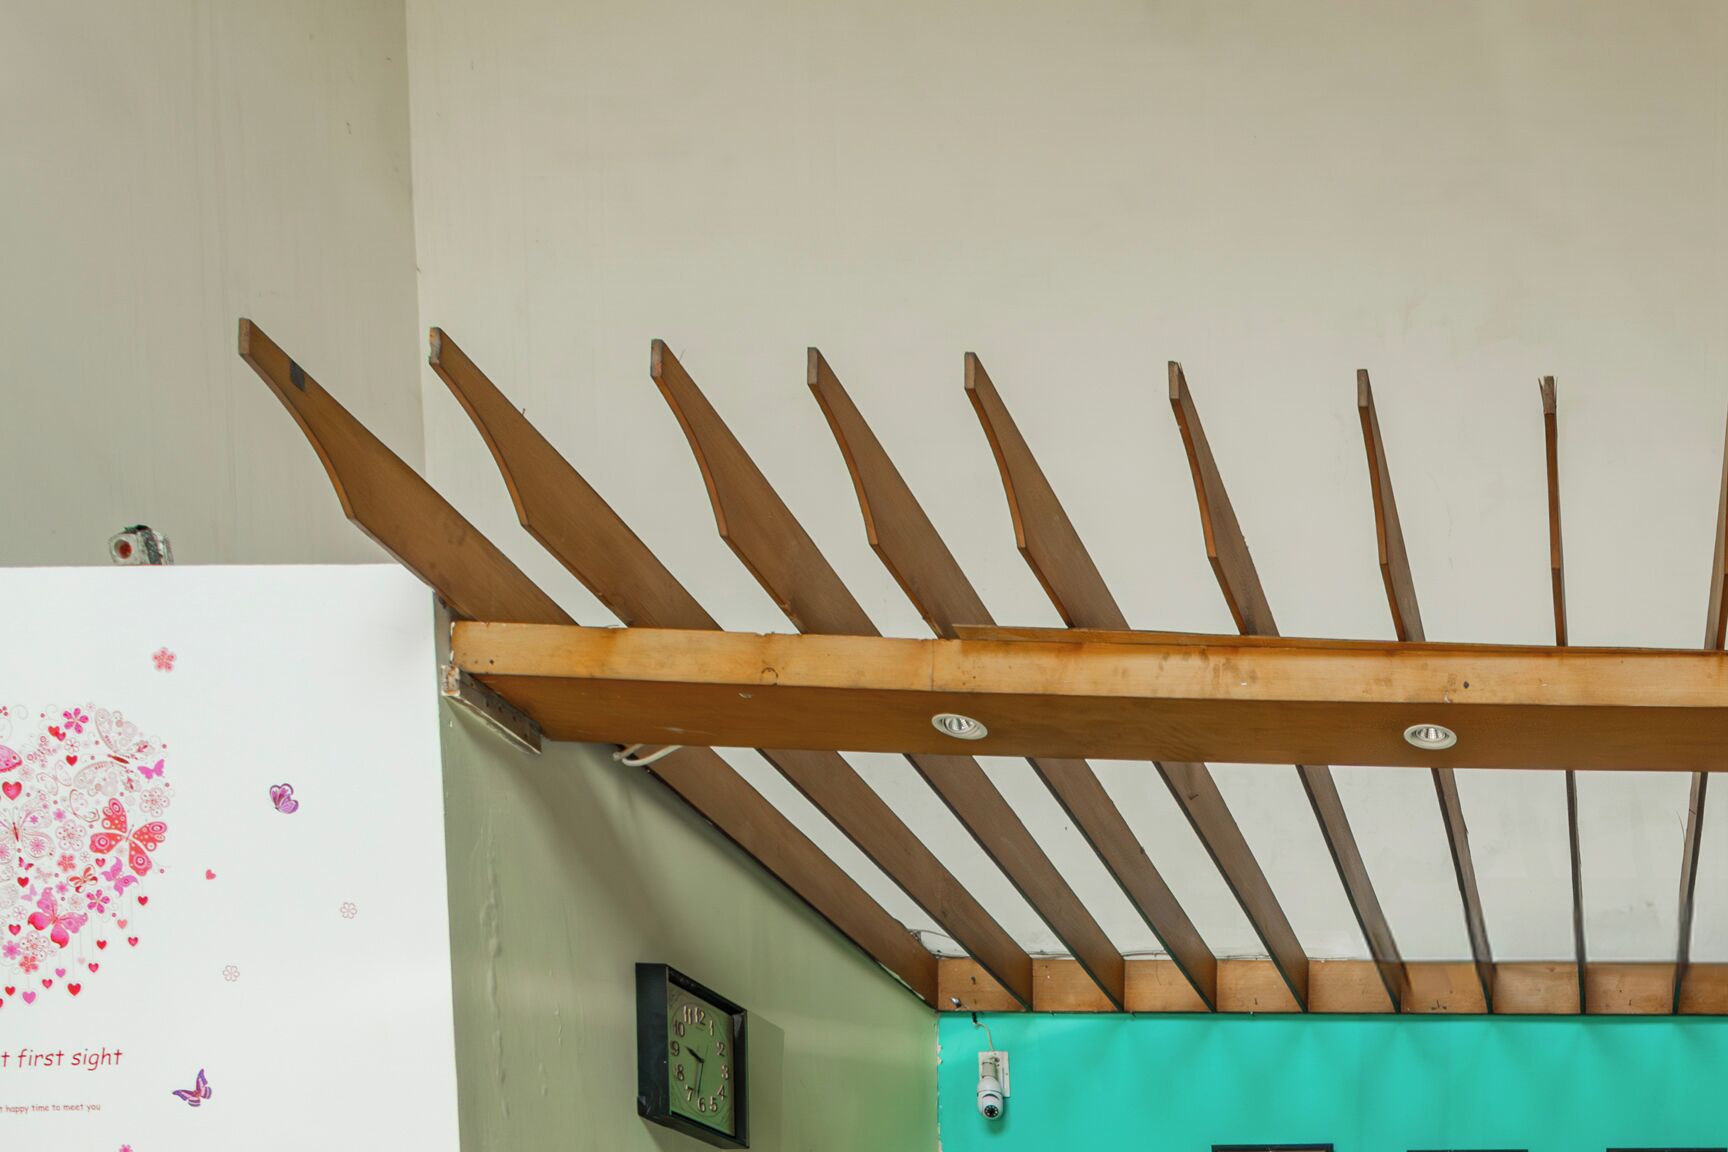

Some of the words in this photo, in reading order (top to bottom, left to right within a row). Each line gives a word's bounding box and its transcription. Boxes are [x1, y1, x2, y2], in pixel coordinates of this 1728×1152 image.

[694, 1007, 706, 1026] 12
[708, 1019, 714, 1037] 1
[671, 1041, 680, 1057] 9
[716, 1040, 726, 1057] 2
[17, 1048, 64, 1068] first
[71, 1047, 123, 1071] sight
[675, 1063, 684, 1081] 8
[685, 1083, 693, 1101] 7
[716, 1084, 726, 1101] 4
[5, 1105, 28, 1115] happy
[31, 1104, 49, 1112] time
[51, 1104, 60, 1112] to
[86, 1104, 101, 1113] you
[697, 1097, 706, 1113] 6
[709, 1095, 718, 1113] 5
